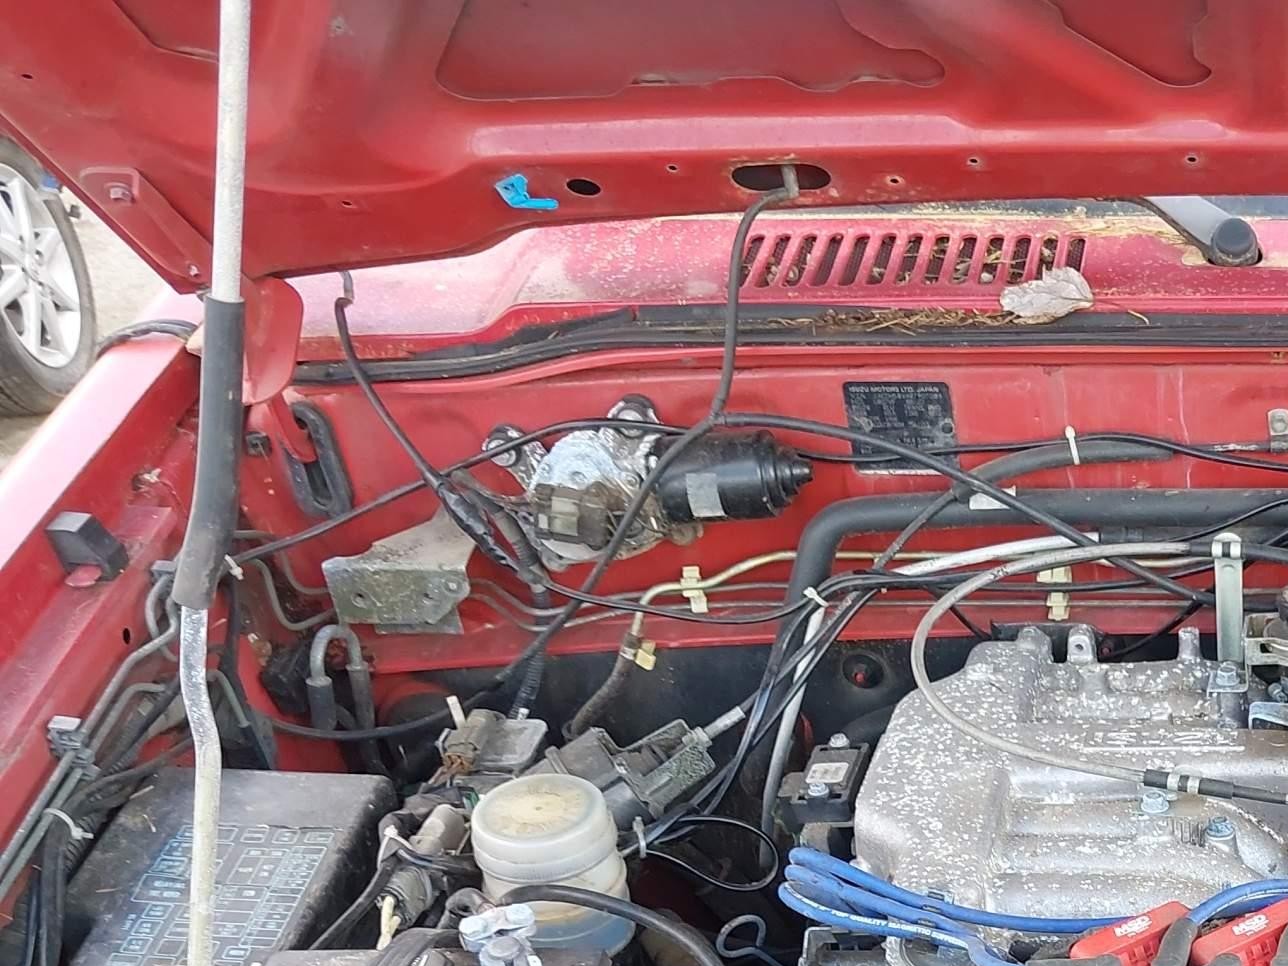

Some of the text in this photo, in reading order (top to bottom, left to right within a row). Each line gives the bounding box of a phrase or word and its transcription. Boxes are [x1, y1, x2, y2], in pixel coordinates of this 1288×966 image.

[849, 914, 888, 927] QUALITY
[1114, 915, 1150, 937] MSD
[1232, 914, 1268, 935] MSD
